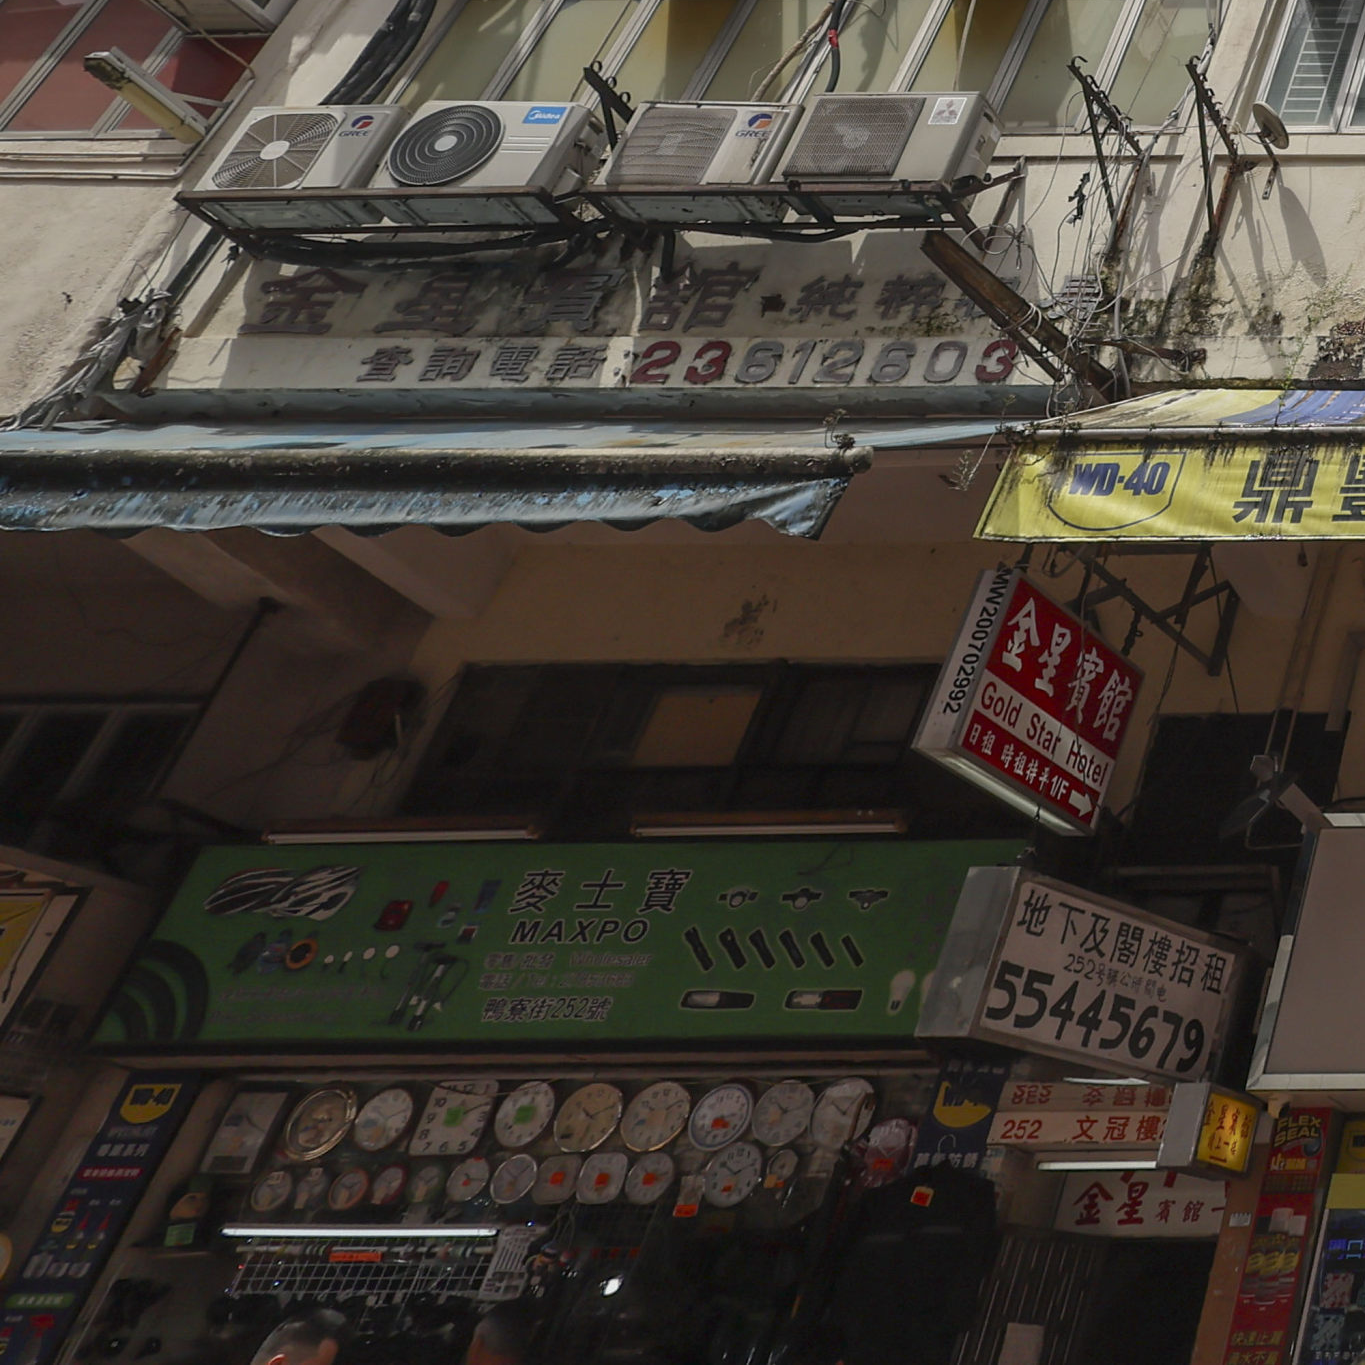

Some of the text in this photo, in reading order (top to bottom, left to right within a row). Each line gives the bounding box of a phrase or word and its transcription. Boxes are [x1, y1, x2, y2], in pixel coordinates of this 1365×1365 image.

[528, 109, 562, 122] Midea
[734, 129, 774, 138] GREE
[1069, 462, 1171, 498] WD-40
[1001, 595, 1134, 743] 金星賓館
[968, 722, 998, 757] 日租
[981, 680, 1109, 788] Gold Star Hotel
[508, 868, 693, 916] 麥士寶
[509, 917, 651, 946] MAXPO
[1016, 889, 1228, 995] 地下及閣樓招租
[480, 996, 614, 1023] 鴨寮街252號
[985, 959, 1206, 1074] 55445679
[999, 1114, 1168, 1141] 252 文冠樓
[1273, 1126, 1320, 1147] SEAL
[1276, 1114, 1323, 1133] FLEX
